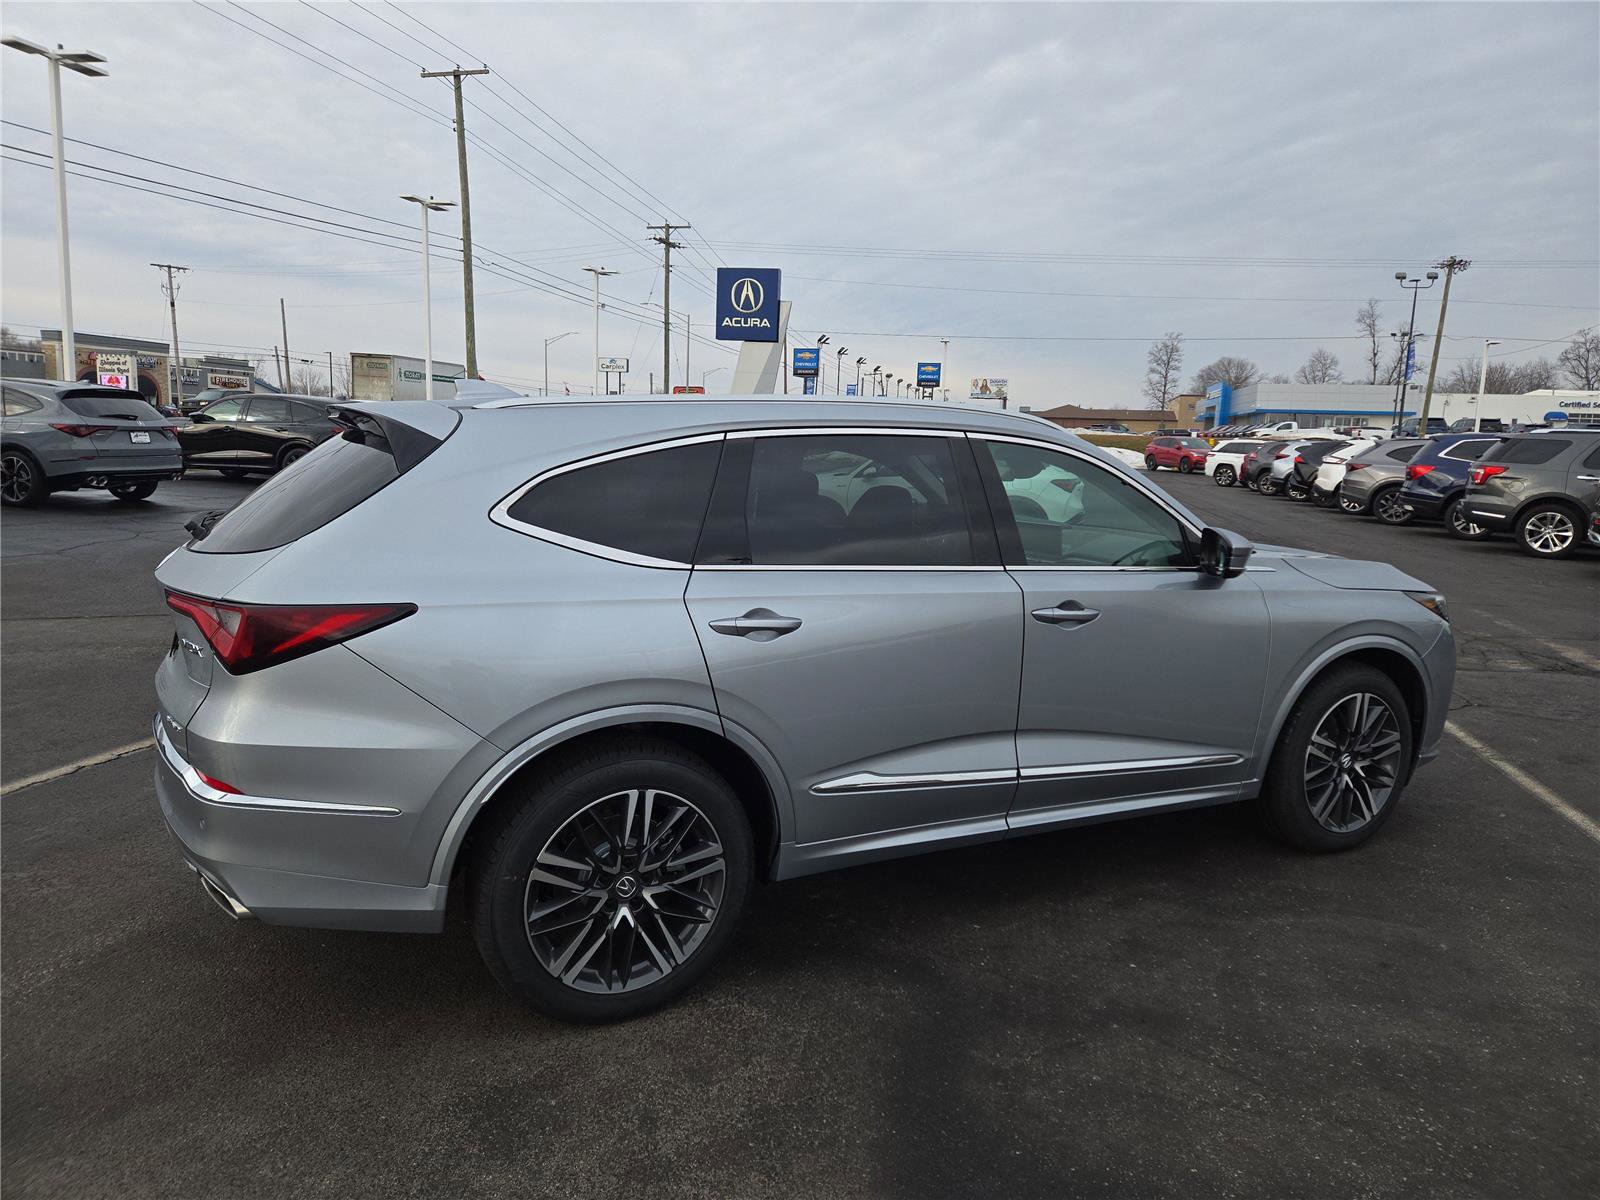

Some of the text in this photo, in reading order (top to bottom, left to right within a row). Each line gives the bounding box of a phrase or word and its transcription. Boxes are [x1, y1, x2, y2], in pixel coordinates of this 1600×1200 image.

[721, 317, 771, 328] ACURA
[600, 363, 625, 371] Carplex
[216, 376, 248, 386] FIREHOUSE
[1559, 400, 1591, 408] Certified
